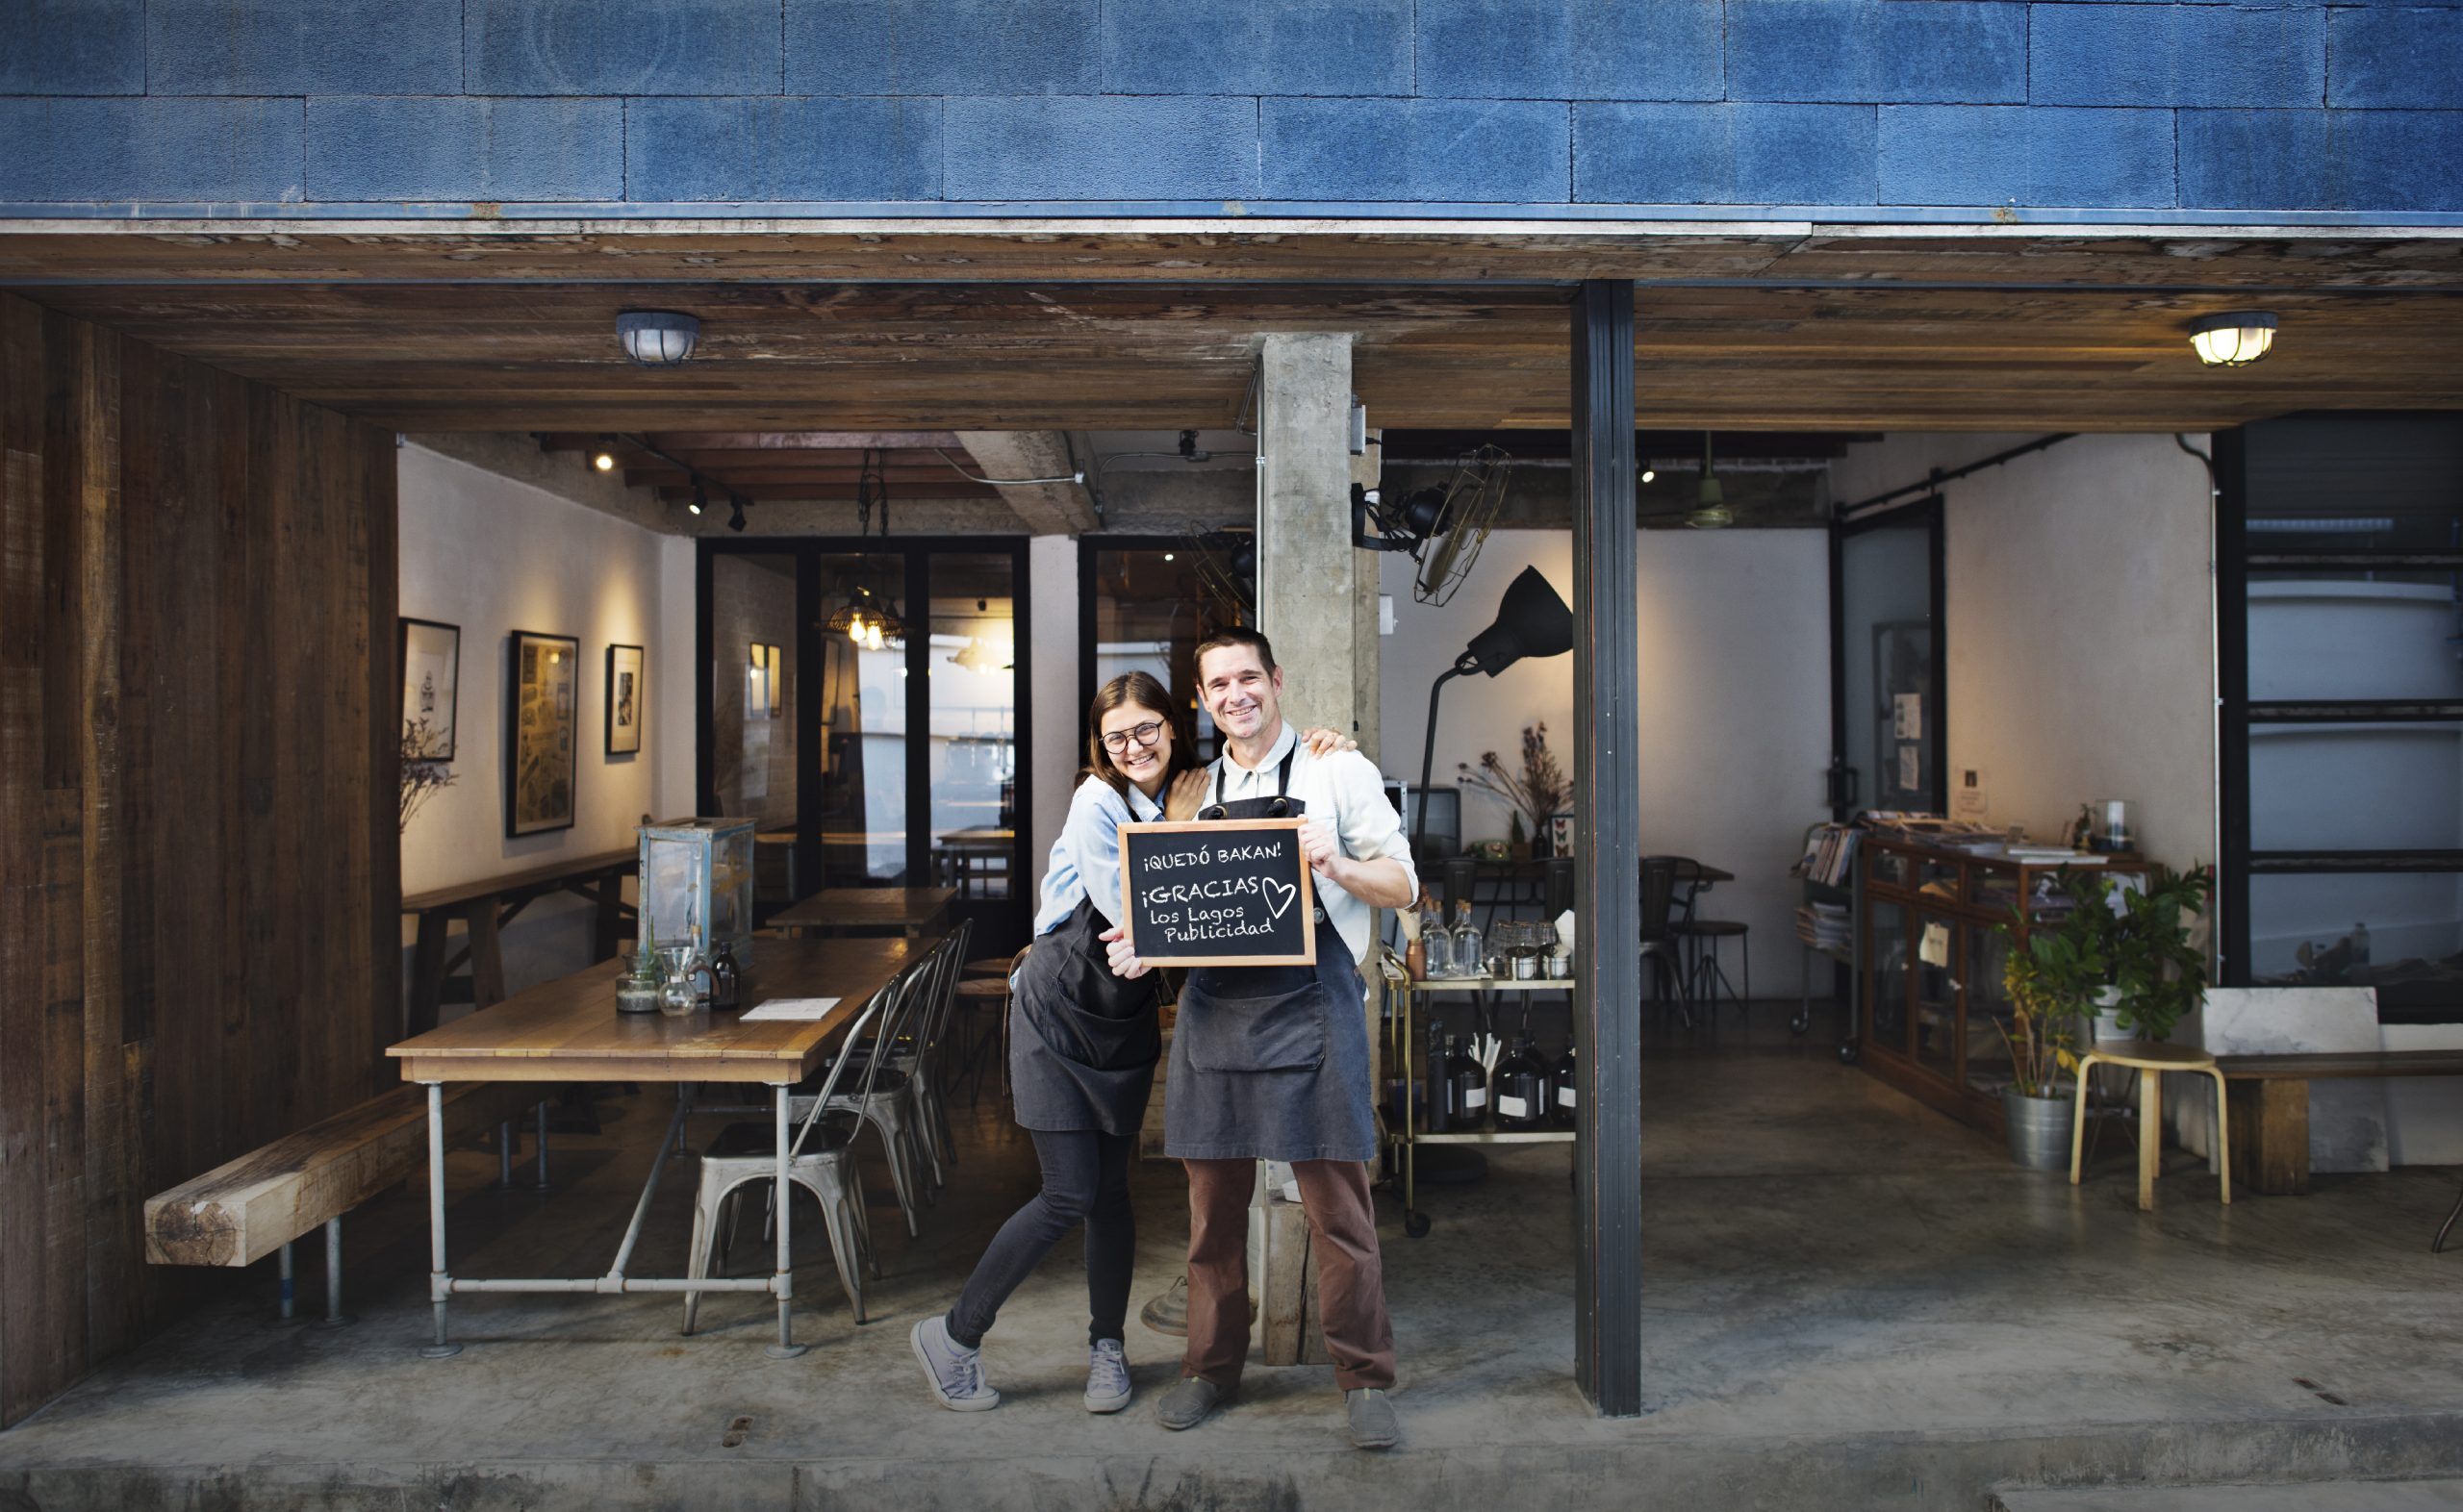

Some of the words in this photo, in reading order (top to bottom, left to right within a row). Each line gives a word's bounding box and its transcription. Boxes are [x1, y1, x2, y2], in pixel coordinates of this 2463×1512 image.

[1144, 844, 1210, 871] ¡QUEDÓ
[1217, 842, 1282, 864] BAKAN!
[1141, 876, 1258, 908] ¡GRACIAS
[1188, 907, 1244, 925] Lagos
[1164, 918, 1275, 943] Publicidad
